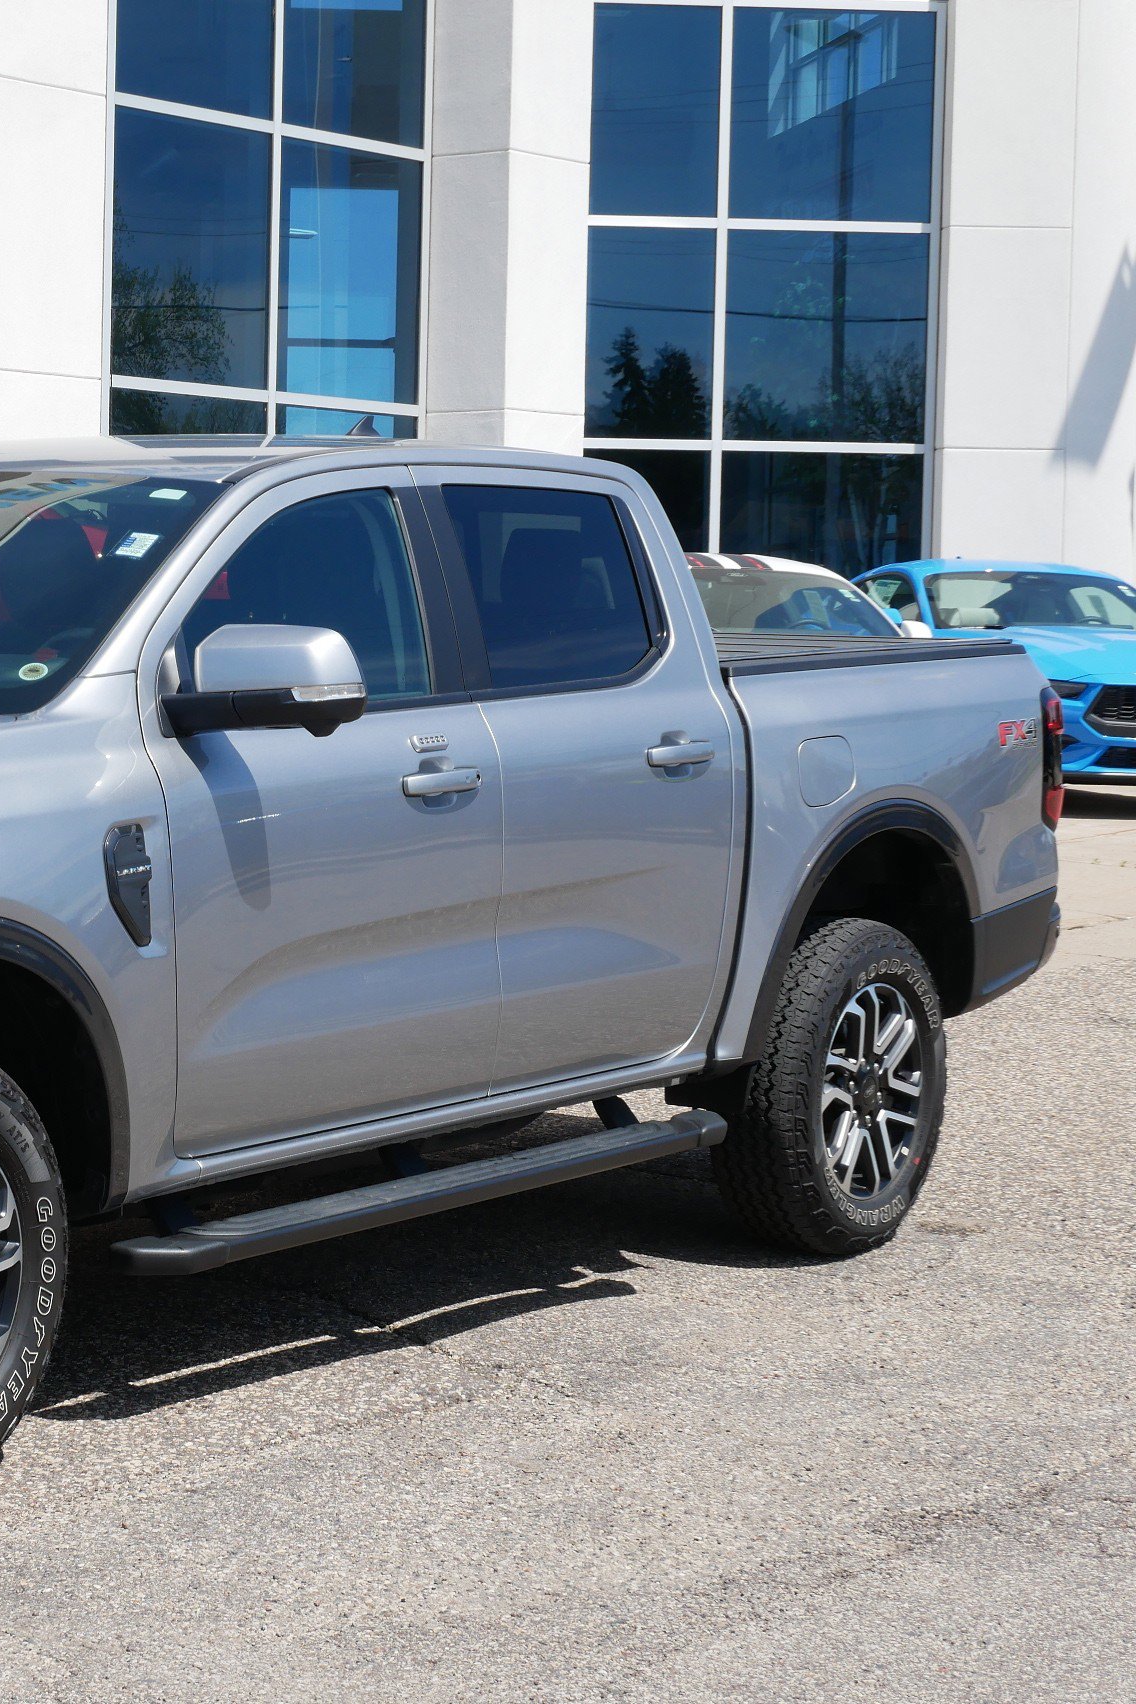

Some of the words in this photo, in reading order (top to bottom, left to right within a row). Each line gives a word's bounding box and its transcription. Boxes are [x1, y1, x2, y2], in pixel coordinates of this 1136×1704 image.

[997, 717, 1038, 747] FX4
[856, 958, 939, 1029] GOODYEAR
[825, 1167, 906, 1227] WRANGLER
